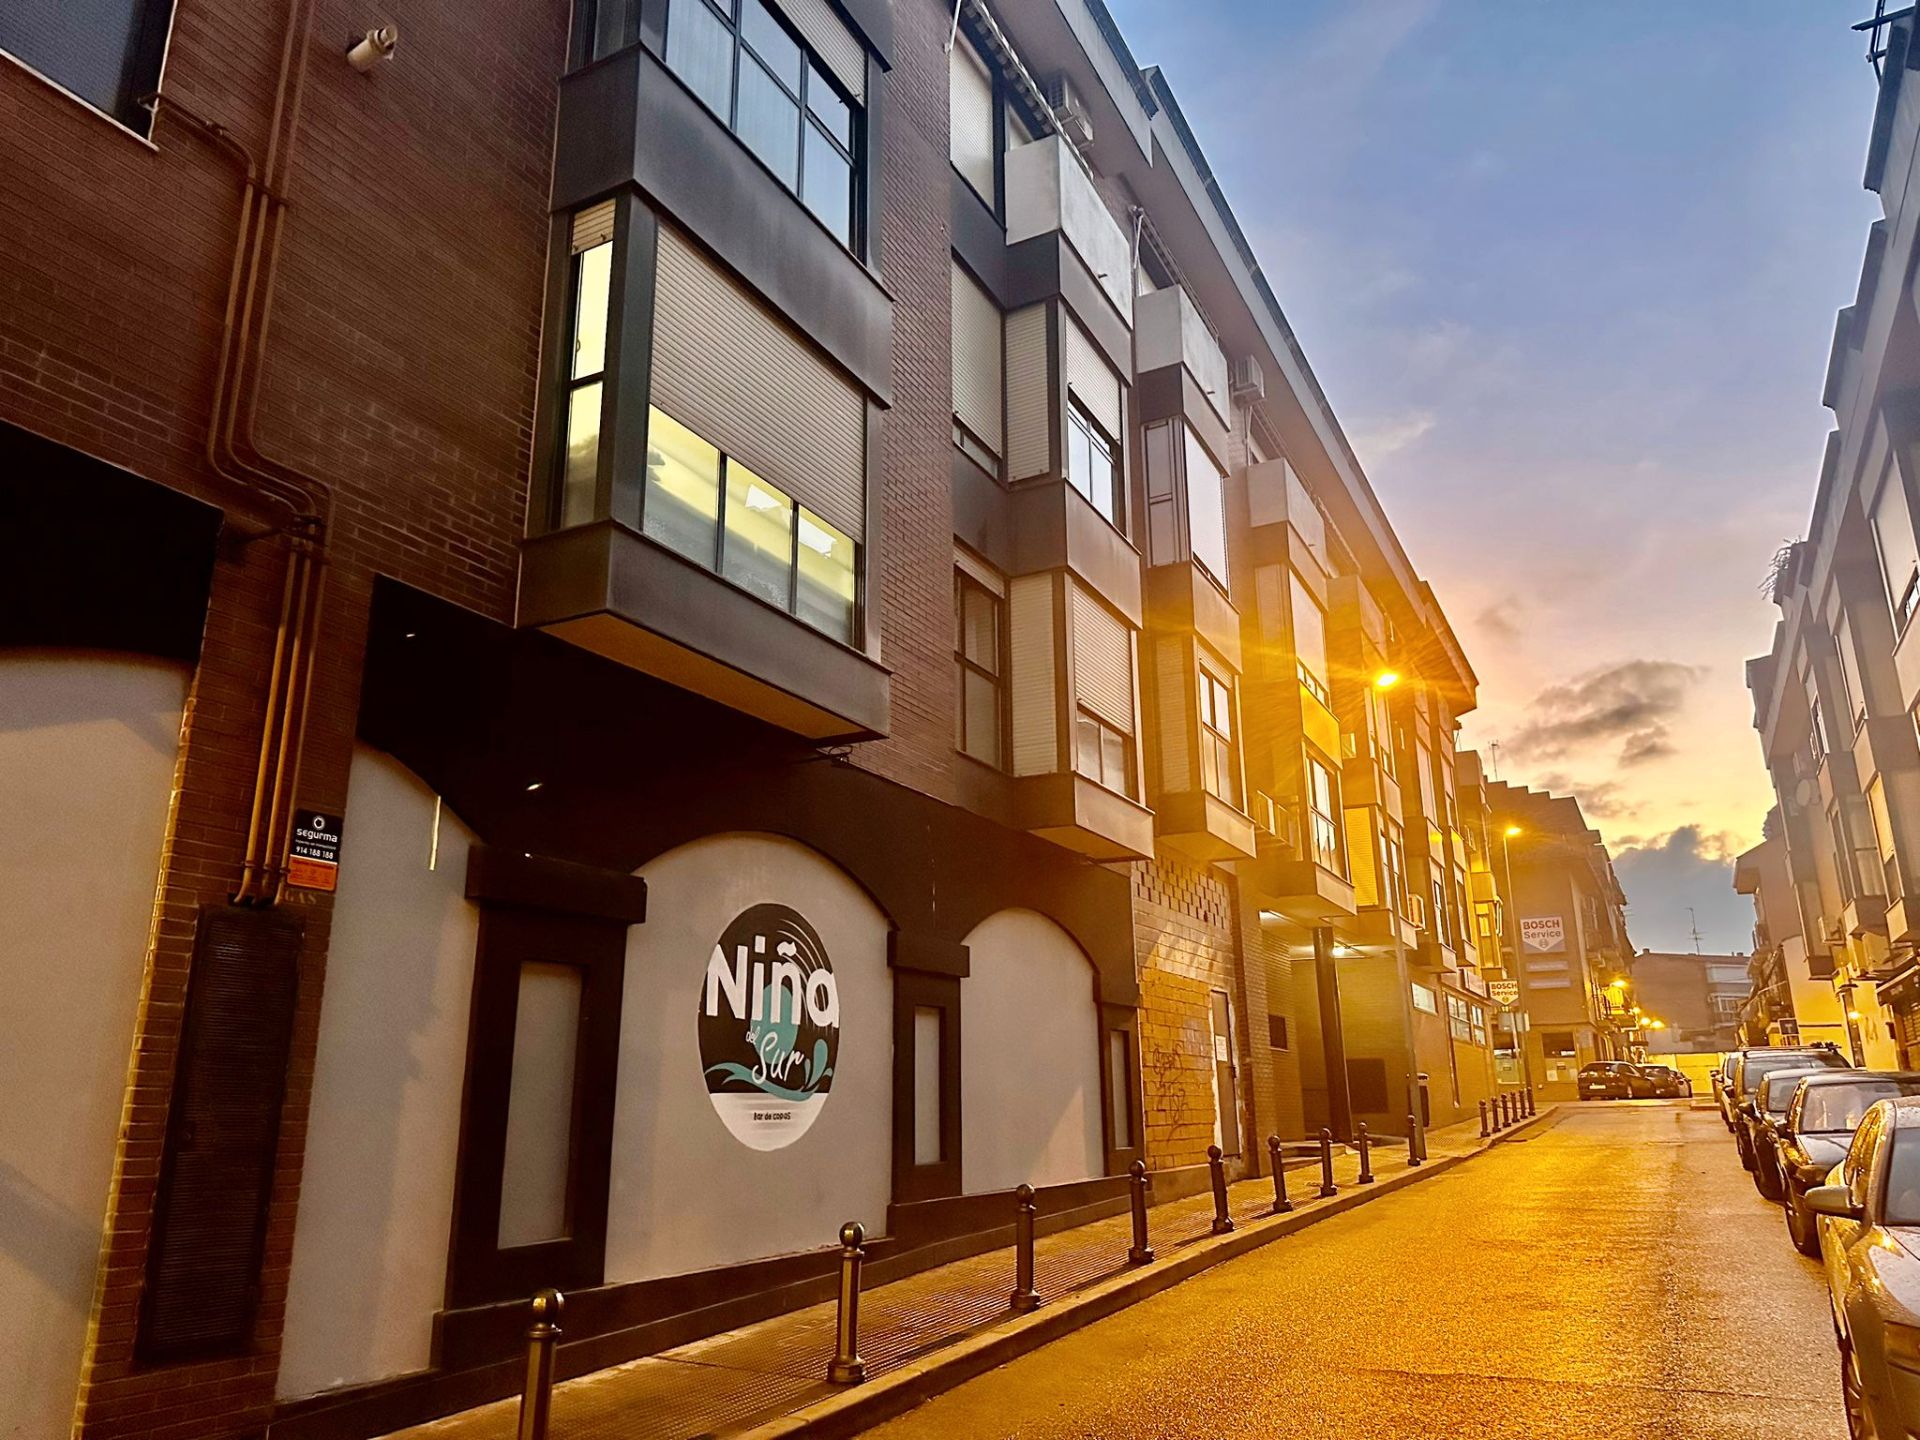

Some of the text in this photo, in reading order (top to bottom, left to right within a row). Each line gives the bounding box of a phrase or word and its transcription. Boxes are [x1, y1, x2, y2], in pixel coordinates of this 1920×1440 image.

[296, 828, 338, 843] segurma
[296, 846, 308, 854] 914
[1523, 919, 1560, 930] BOSCH
[1523, 930, 1561, 940] Service
[706, 935, 839, 1029] Niña
[1491, 982, 1517, 990] BOSCH
[752, 1031, 805, 1085] Sur
